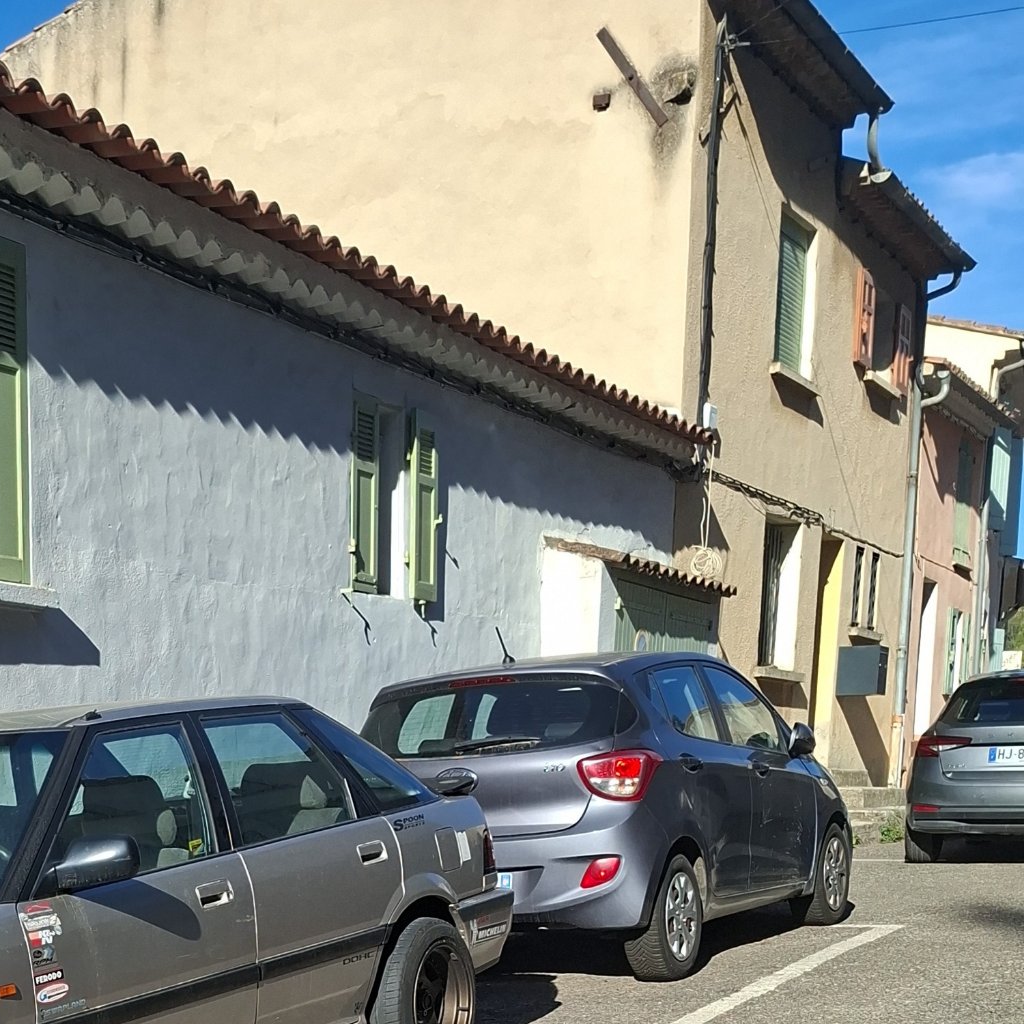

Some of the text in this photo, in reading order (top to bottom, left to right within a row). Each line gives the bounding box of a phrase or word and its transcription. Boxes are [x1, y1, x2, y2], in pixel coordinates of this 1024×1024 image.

[394, 813, 424, 831] SPOON
[478, 923, 507, 940] MICHELIN
[342, 951, 375, 966] DOHC
[35, 970, 62, 985] FERODO
